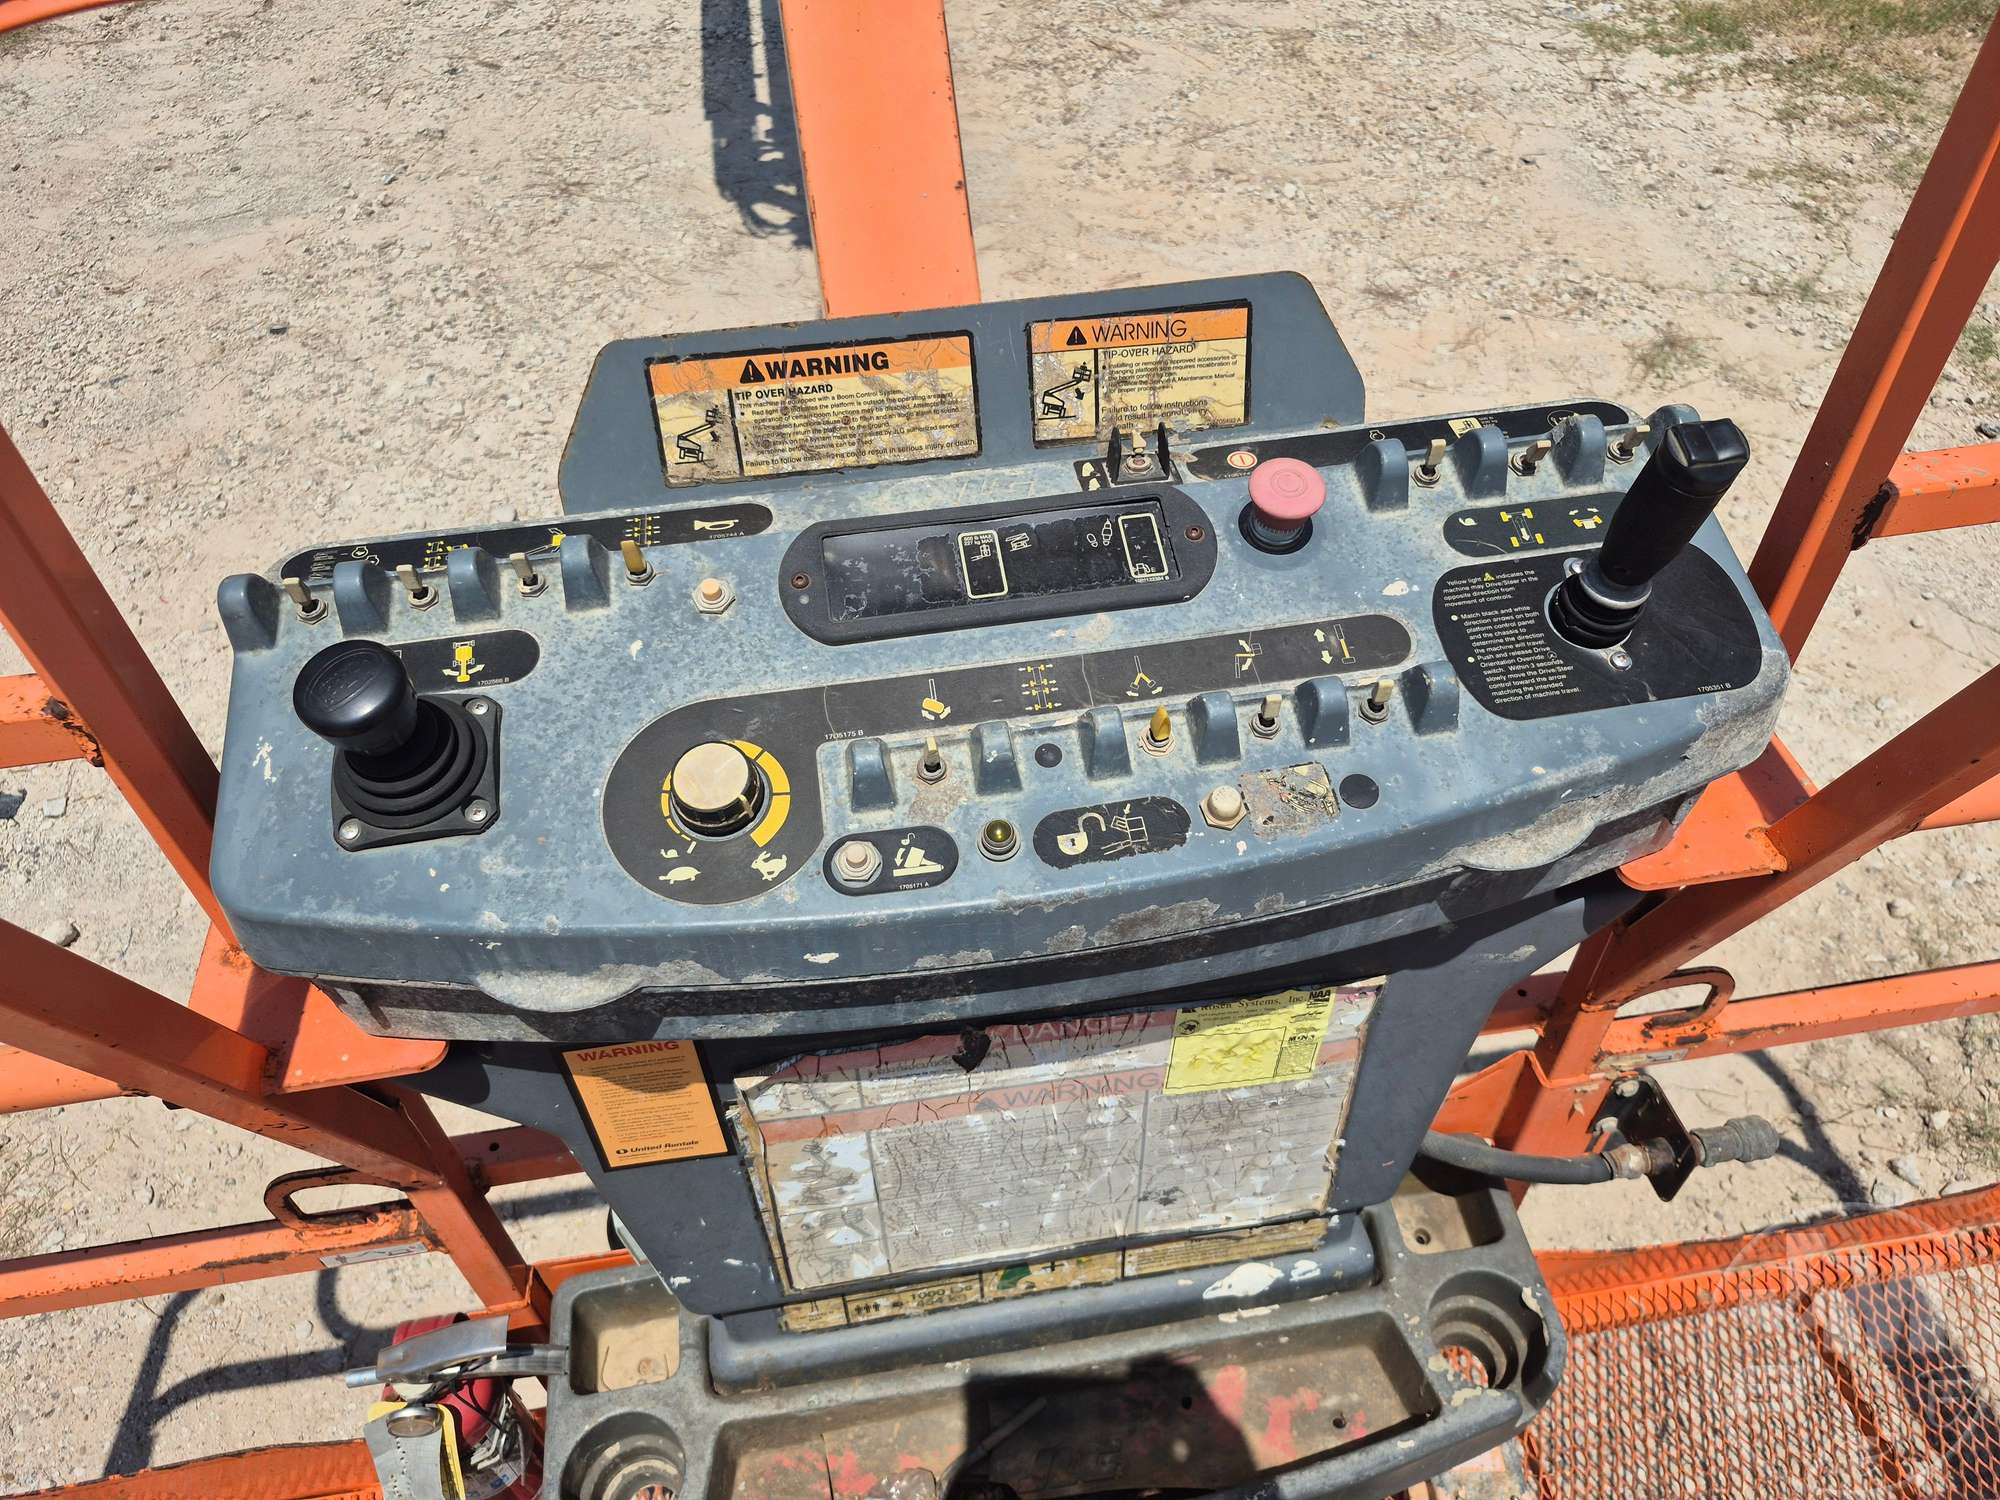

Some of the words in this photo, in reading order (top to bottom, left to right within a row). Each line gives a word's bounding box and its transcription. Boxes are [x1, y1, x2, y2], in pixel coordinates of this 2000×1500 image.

[1091, 319, 1187, 343] WARNING
[1103, 347, 1148, 359] TIP-OVER
[1151, 344, 1193, 355] HAZARD
[1196, 354, 1229, 362] accessories
[765, 351, 890, 380] WARNING
[1172, 362, 1195, 370] requires
[1196, 360, 1231, 368] recalibration
[1177, 374, 1213, 382] Maintenance
[735, 391, 751, 401] TIP
[755, 387, 785, 399] OVER
[788, 382, 833, 396] HAZARD
[753, 400, 779, 408] machine
[765, 407, 778, 415] light
[830, 400, 855, 410] platform
[862, 398, 884, 406] outside
[897, 394, 925, 403] operating
[1130, 404, 1137, 412] to
[1139, 402, 1162, 411] follow
[1164, 398, 1207, 408] instructions
[832, 407, 868, 417] functions
[1124, 411, 1145, 420] result
[906, 424, 937, 433] authorized
[938, 422, 960, 430] service
[745, 458, 770, 467] Failure
[779, 455, 801, 464] follow
[897, 444, 922, 453] serious
[1123, 522, 1129, 531] F
[1442, 585, 1469, 594] machine
[1485, 577, 1520, 588] Drive/Steer
[1446, 578, 1466, 586] Yellow
[1468, 576, 1481, 584] light
[1495, 570, 1523, 580] indicates
[1443, 592, 1471, 602] opposite
[1471, 588, 1499, 597] direction
[1500, 585, 1515, 593] from
[1444, 598, 1477, 608] movement
[1485, 592, 1512, 602] controls.
[1460, 611, 1480, 620] Match
[1513, 604, 1530, 612] white
[1463, 617, 1491, 626] direction
[1492, 614, 1514, 622] arrows
[1466, 624, 1492, 634] platform
[1493, 621, 1516, 629] control
[1517, 618, 1535, 626] panel
[1471, 637, 1503, 647] determine
[1516, 631, 1544, 640] direction
[1493, 628, 1518, 637] chassis
[1486, 643, 1513, 652] machine
[1526, 638, 1545, 646] travel.
[1477, 653, 1494, 661] Push
[1508, 648, 1532, 657] release
[1533, 645, 1550, 653] Drive
[1479, 657, 1515, 668] Orientation
[1516, 653, 1544, 663] Override
[1483, 666, 1505, 675] switch.
[1508, 663, 1530, 671] Within
[1535, 658, 1563, 667] seconds
[1486, 674, 1506, 683] slowly
[1538, 664, 1574, 675] Drive/Steer
[504, 675, 511, 683] B
[1488, 680, 1511, 689] control
[1512, 677, 1535, 686] toward
[1548, 673, 1566, 681] arrow
[1724, 681, 1732, 689] B
[1491, 687, 1522, 697] matching
[1534, 681, 1563, 690] intended
[1494, 694, 1522, 704] direction
[1532, 689, 1559, 698] machine
[924, 880, 930, 888] A
[1238, 998, 1281, 1009] Systems,
[1288, 994, 1307, 1004] Inc.
[1308, 989, 1331, 1000] NAA
[1013, 1013, 1155, 1041] DANGER
[577, 1041, 679, 1063] WARNING
[1002, 1070, 1161, 1108] WARNING
[630, 1143, 663, 1153] United
[663, 1139, 700, 1150] Rentals
[911, 1288, 945, 1300] 1000
